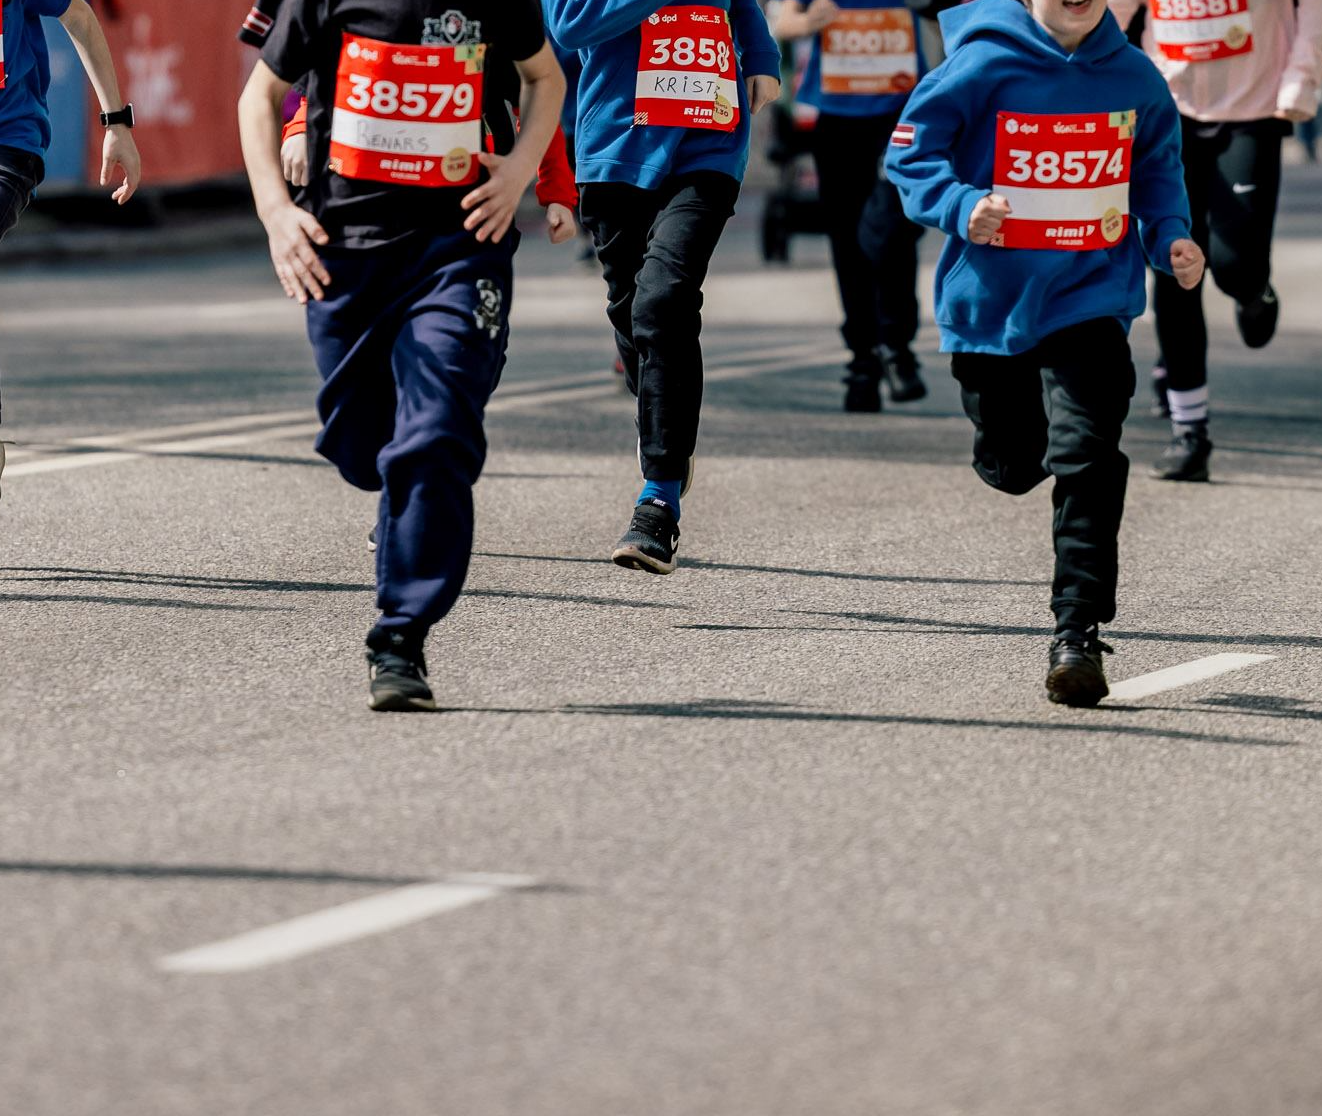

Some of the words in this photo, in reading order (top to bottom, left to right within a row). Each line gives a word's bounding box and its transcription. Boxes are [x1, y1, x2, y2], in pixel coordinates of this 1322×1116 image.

[662, 14, 677, 24] dpd
[346, 73, 475, 118] 38579
[1006, 147, 1124, 184] 38574
